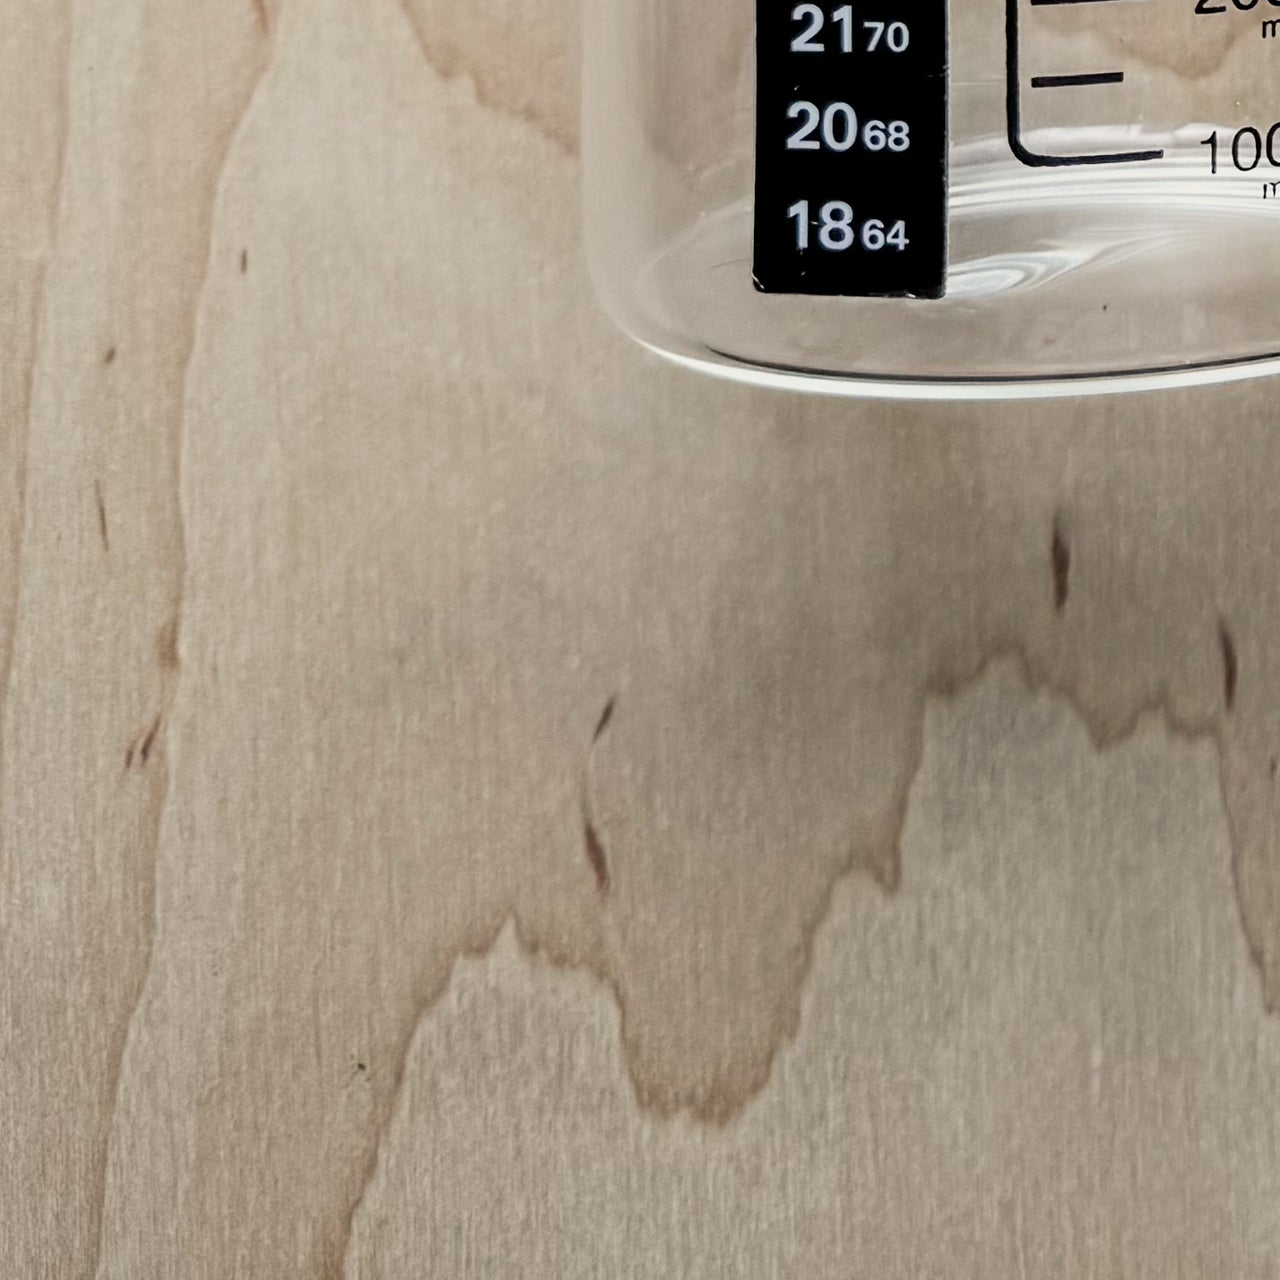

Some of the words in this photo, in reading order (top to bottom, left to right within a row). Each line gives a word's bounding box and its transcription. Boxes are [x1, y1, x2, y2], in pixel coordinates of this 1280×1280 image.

[789, 3, 852, 51] 21
[862, 20, 909, 51] 70
[785, 100, 857, 149] 20
[862, 119, 909, 148] 68
[785, 199, 854, 249] 18
[861, 218, 909, 249] 64
